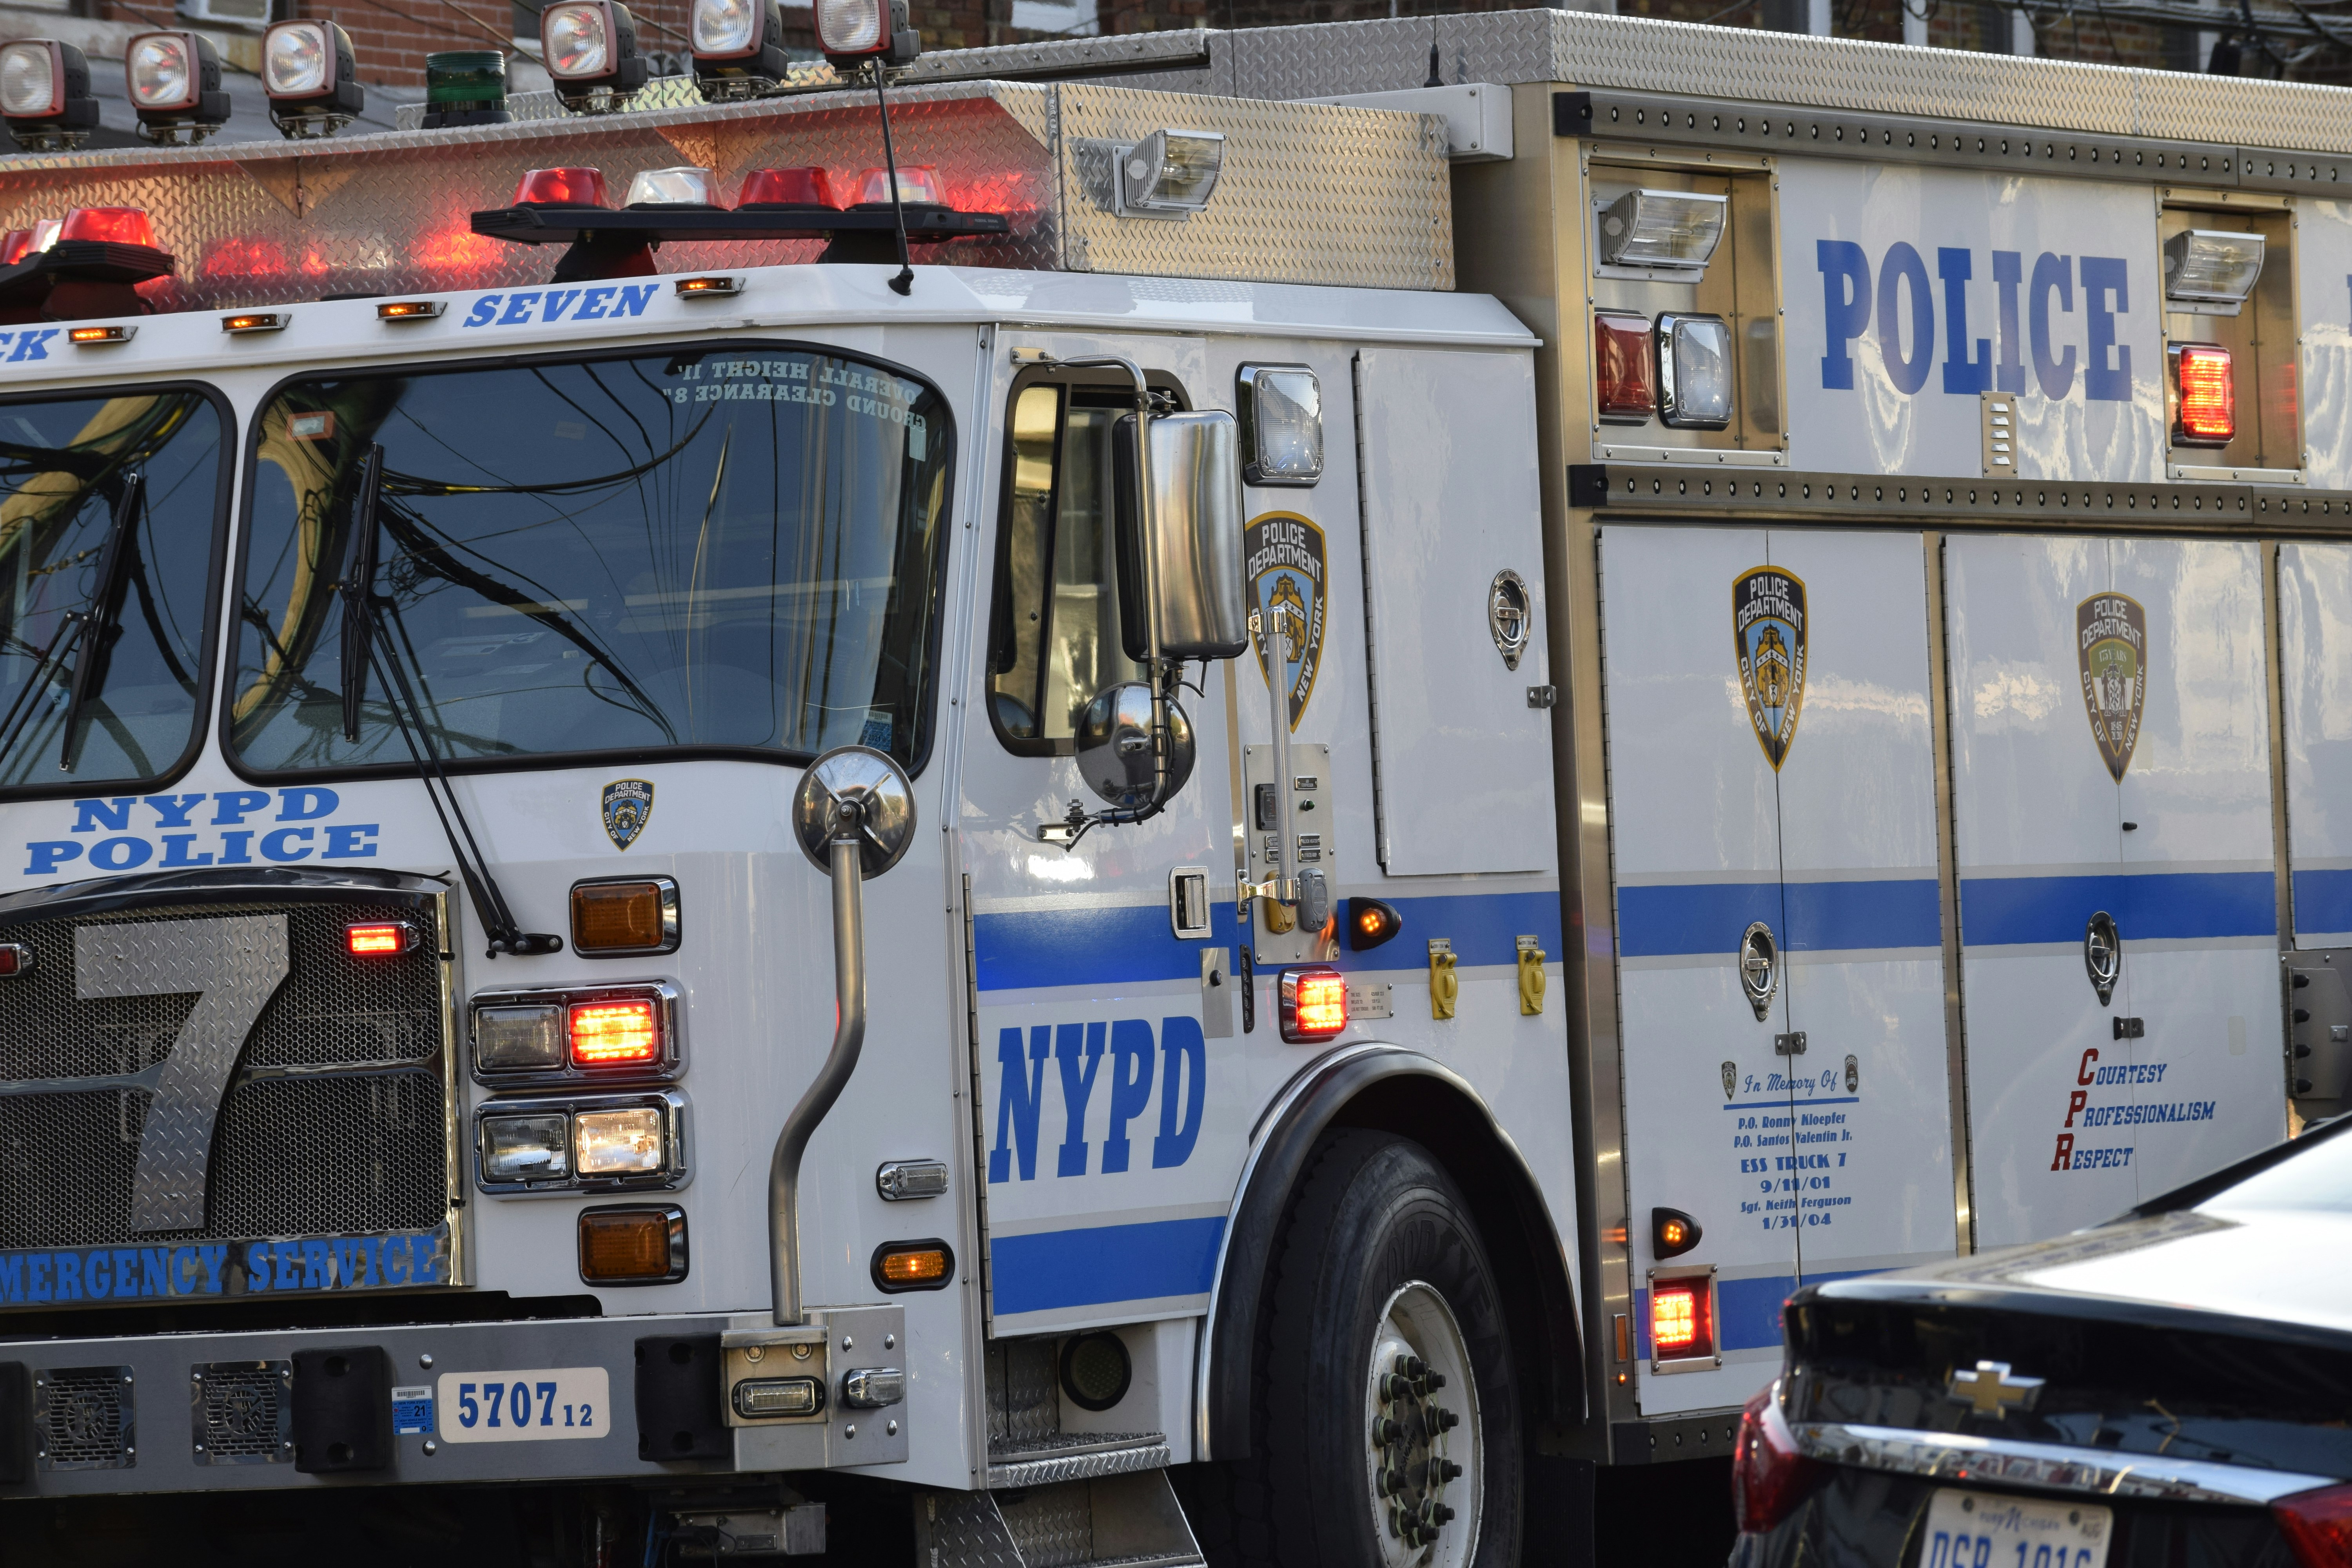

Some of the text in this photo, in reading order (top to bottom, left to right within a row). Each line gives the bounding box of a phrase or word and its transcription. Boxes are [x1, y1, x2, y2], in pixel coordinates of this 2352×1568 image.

[463, 284, 660, 327] SEVEN
[1815, 239, 2133, 402] POLICE
[1262, 522, 1306, 548] POLICE
[1248, 544, 1321, 583] DEPARTMENT
[1750, 576, 1789, 601] POLICE
[1738, 597, 1803, 633] DEPARTMENT
[2094, 599, 2127, 620] POLICE
[1252, 607, 1268, 655] CTY
[2082, 619, 2142, 650] DEPARTMENT
[1296, 596, 1323, 703] NEW YORK
[1740, 656, 1768, 733] CITY OF
[1780, 644, 1804, 744] NEW YORK
[2083, 671, 2106, 742] CITY OF
[2125, 664, 2143, 751] NEW YORK
[605, 789, 650, 804] DEPARTMENT
[615, 782, 642, 792] POLICE
[70, 786, 339, 833] NYPD
[604, 811, 619, 840] CITY OF
[627, 806, 650, 842] NEW YORK
[23, 824, 379, 875] POLICE
[74, 913, 289, 1231] 7
[1744, 1074, 1761, 1093] In
[1766, 1073, 1816, 1096] Memory
[1820, 1070, 1838, 1092] Of
[988, 1016, 1206, 1184] NYPD
[1734, 1129, 1852, 1148] P.O. Santos Valentin Jr.
[1738, 1112, 1846, 1130] P.O. Ronny Kloepfer
[1741, 1152, 1847, 1173] ESS TRUCK 7
[1760, 1176, 1830, 1193] 9/11/01
[1741, 1196, 1851, 1214] Sgt. Keith Ferguson
[1762, 1213, 1832, 1230] 1/31/04
[248, 1235, 436, 1291] SERVICE
[414, 1405, 425, 1417] 21
[458, 1381, 557, 1428] 5707
[563, 1404, 592, 1426] 12
